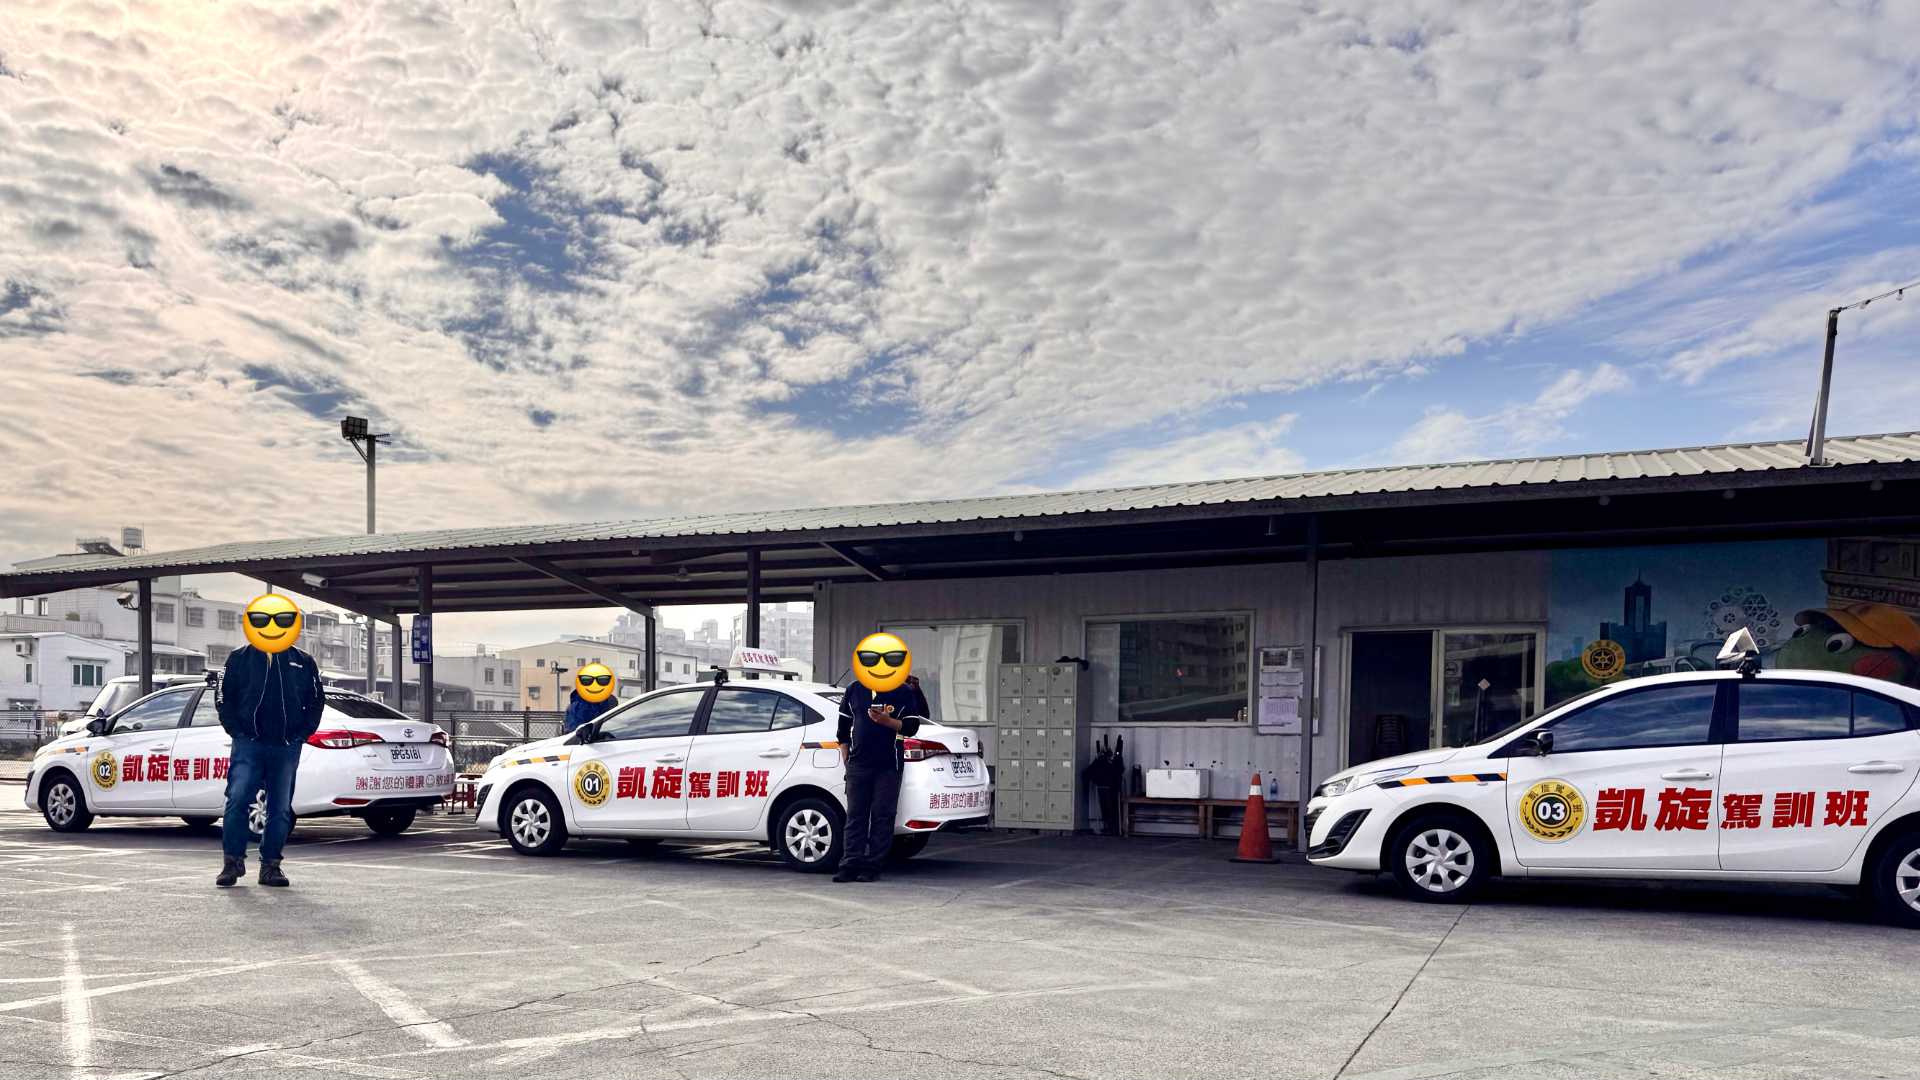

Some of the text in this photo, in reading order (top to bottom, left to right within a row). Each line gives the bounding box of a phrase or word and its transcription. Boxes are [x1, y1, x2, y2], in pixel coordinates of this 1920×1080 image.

[100, 765, 111, 777] 02
[122, 754, 230, 782] 凱旋駕訓班
[585, 778, 599, 792] 01
[617, 766, 770, 799] 凱旋駕訓班
[1538, 802, 1566, 821] 03
[1593, 787, 1870, 832] 凱旋駕訓班
